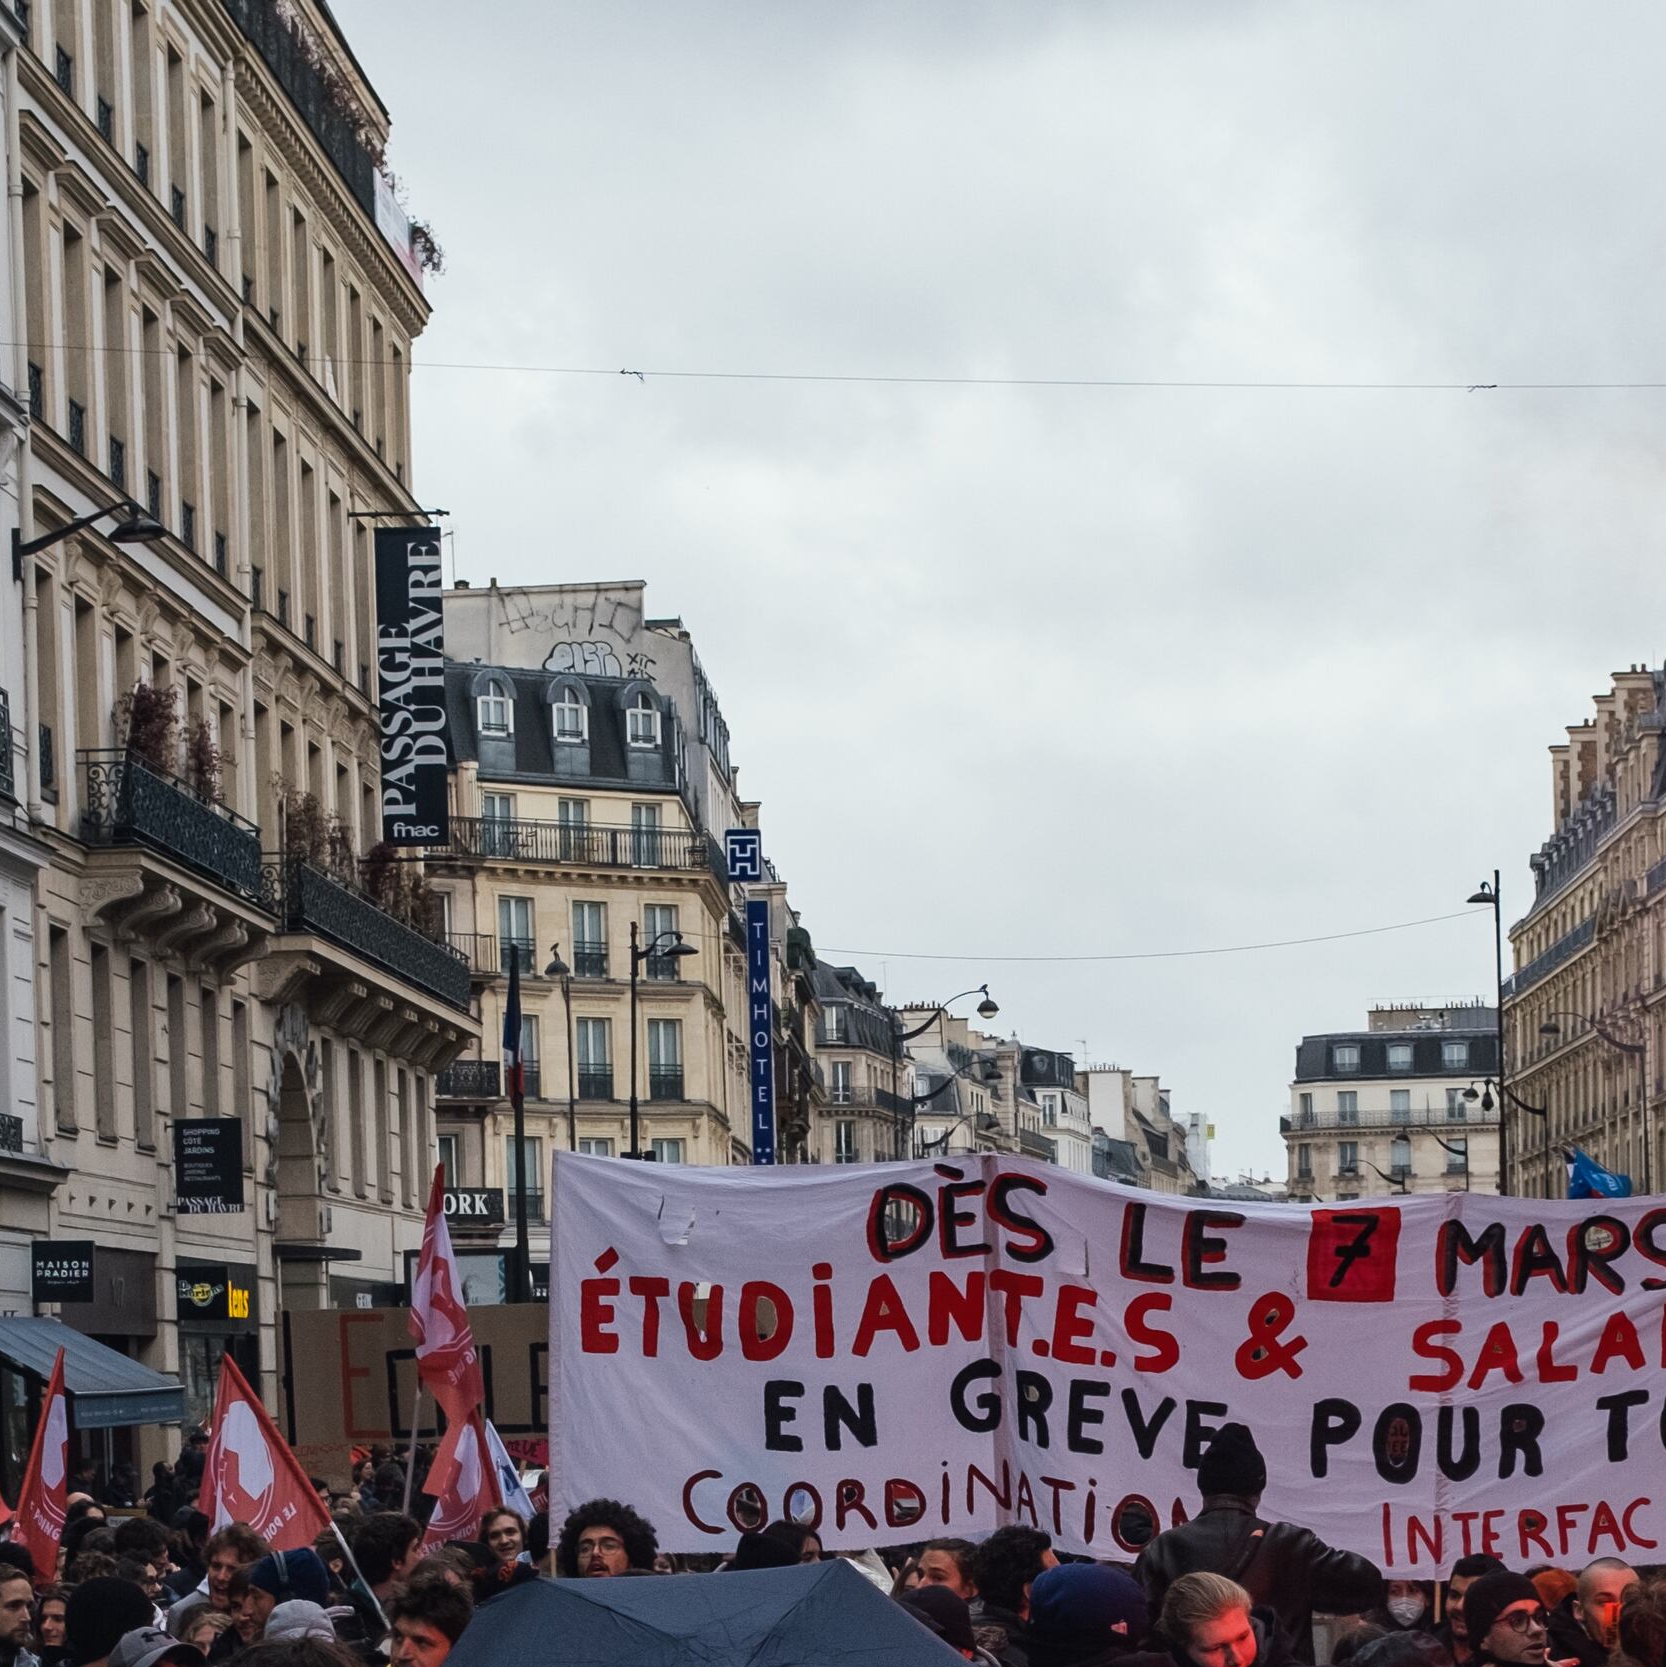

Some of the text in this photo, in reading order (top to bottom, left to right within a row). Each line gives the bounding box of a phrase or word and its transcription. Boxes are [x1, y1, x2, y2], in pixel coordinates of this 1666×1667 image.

[407, 540, 448, 766] DU HAVRE
[378, 624, 416, 817] PASSAGE
[392, 821, 440, 838] fnac
[750, 922, 771, 1131] TIMHOTEL
[183, 1128, 220, 1136] SHOPPING
[183, 1146, 215, 1155] JARDINS
[177, 1196, 223, 1206] PASSAGE
[189, 1202, 245, 1213] DU HAVRE
[444, 1194, 489, 1216] ORK
[867, 1163, 1056, 1263] DÈS
[1119, 1202, 1247, 1291] LE
[1330, 1213, 1380, 1288] 7
[36, 1260, 90, 1269] MAISON
[36, 1269, 90, 1278] PRADIER
[1235, 1291, 1309, 1381] &
[764, 1380, 879, 1453] EN
[1310, 1398, 1546, 1482] POUR
